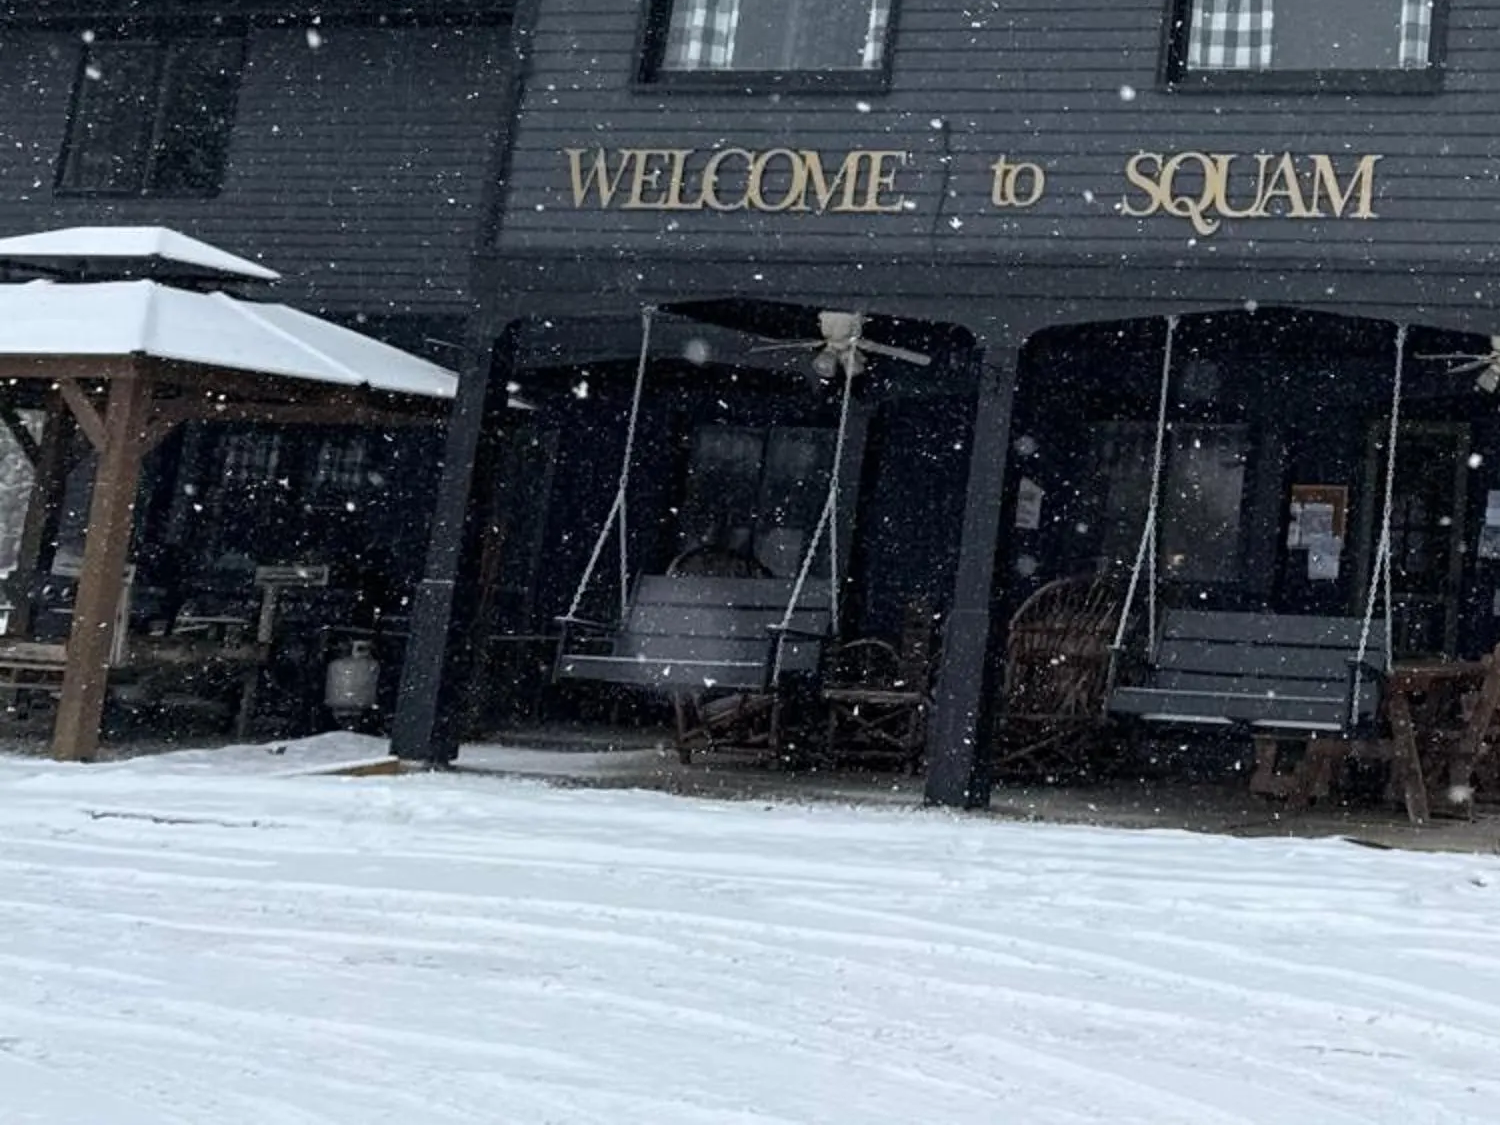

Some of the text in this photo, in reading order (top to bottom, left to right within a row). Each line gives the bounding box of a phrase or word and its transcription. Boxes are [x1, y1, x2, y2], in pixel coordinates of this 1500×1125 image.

[564, 147, 1384, 236] WELCOME to SQUAM
